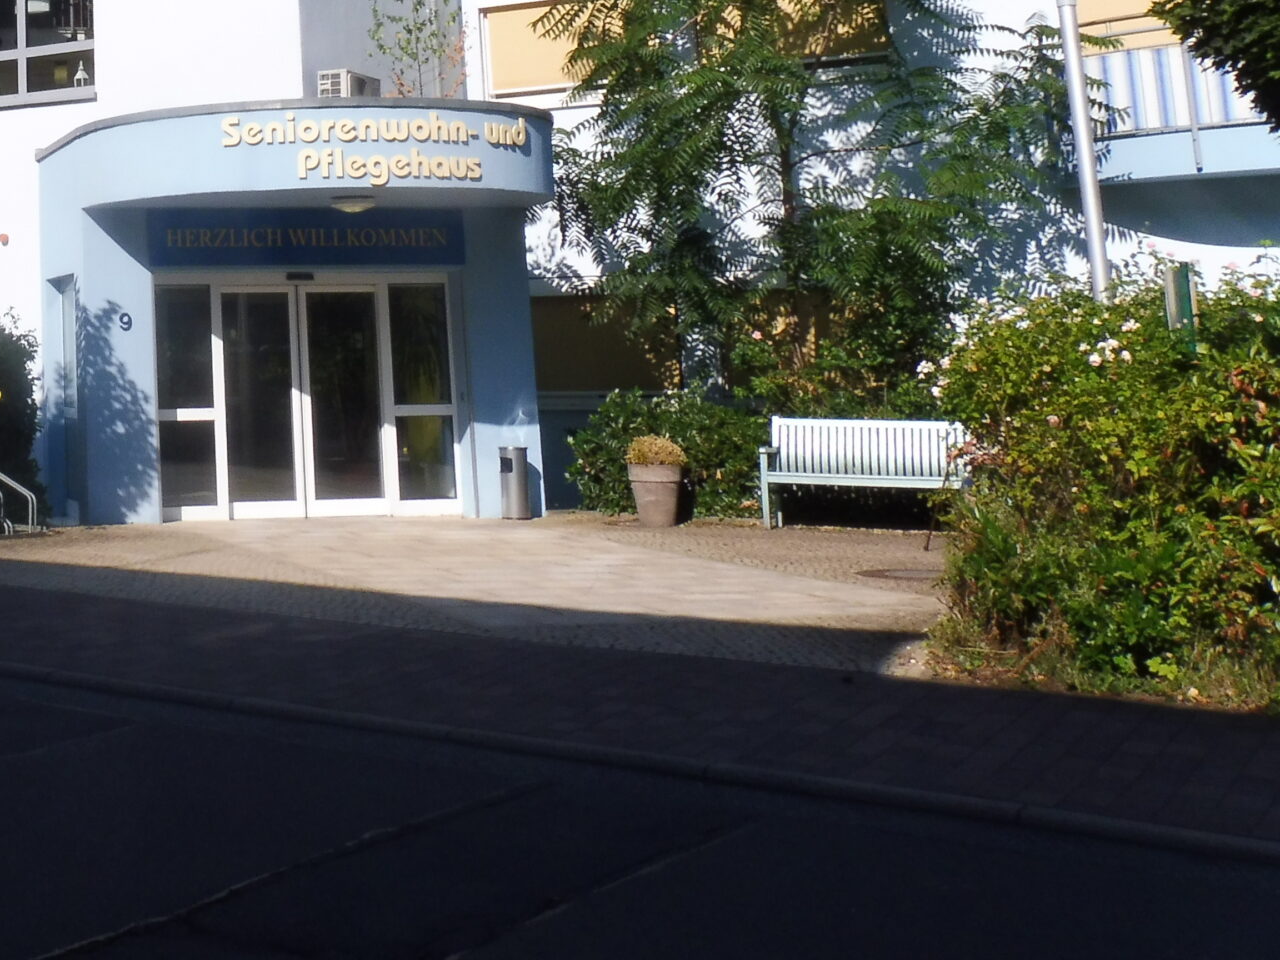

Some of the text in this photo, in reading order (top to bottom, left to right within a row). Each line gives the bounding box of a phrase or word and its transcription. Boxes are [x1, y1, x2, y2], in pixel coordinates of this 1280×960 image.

[221, 112, 527, 148] Seniorenwohn- und
[297, 148, 482, 186] Pflegehaus
[166, 226, 448, 249] HERZLICH WILLKOMMEN
[119, 312, 132, 332] 9
